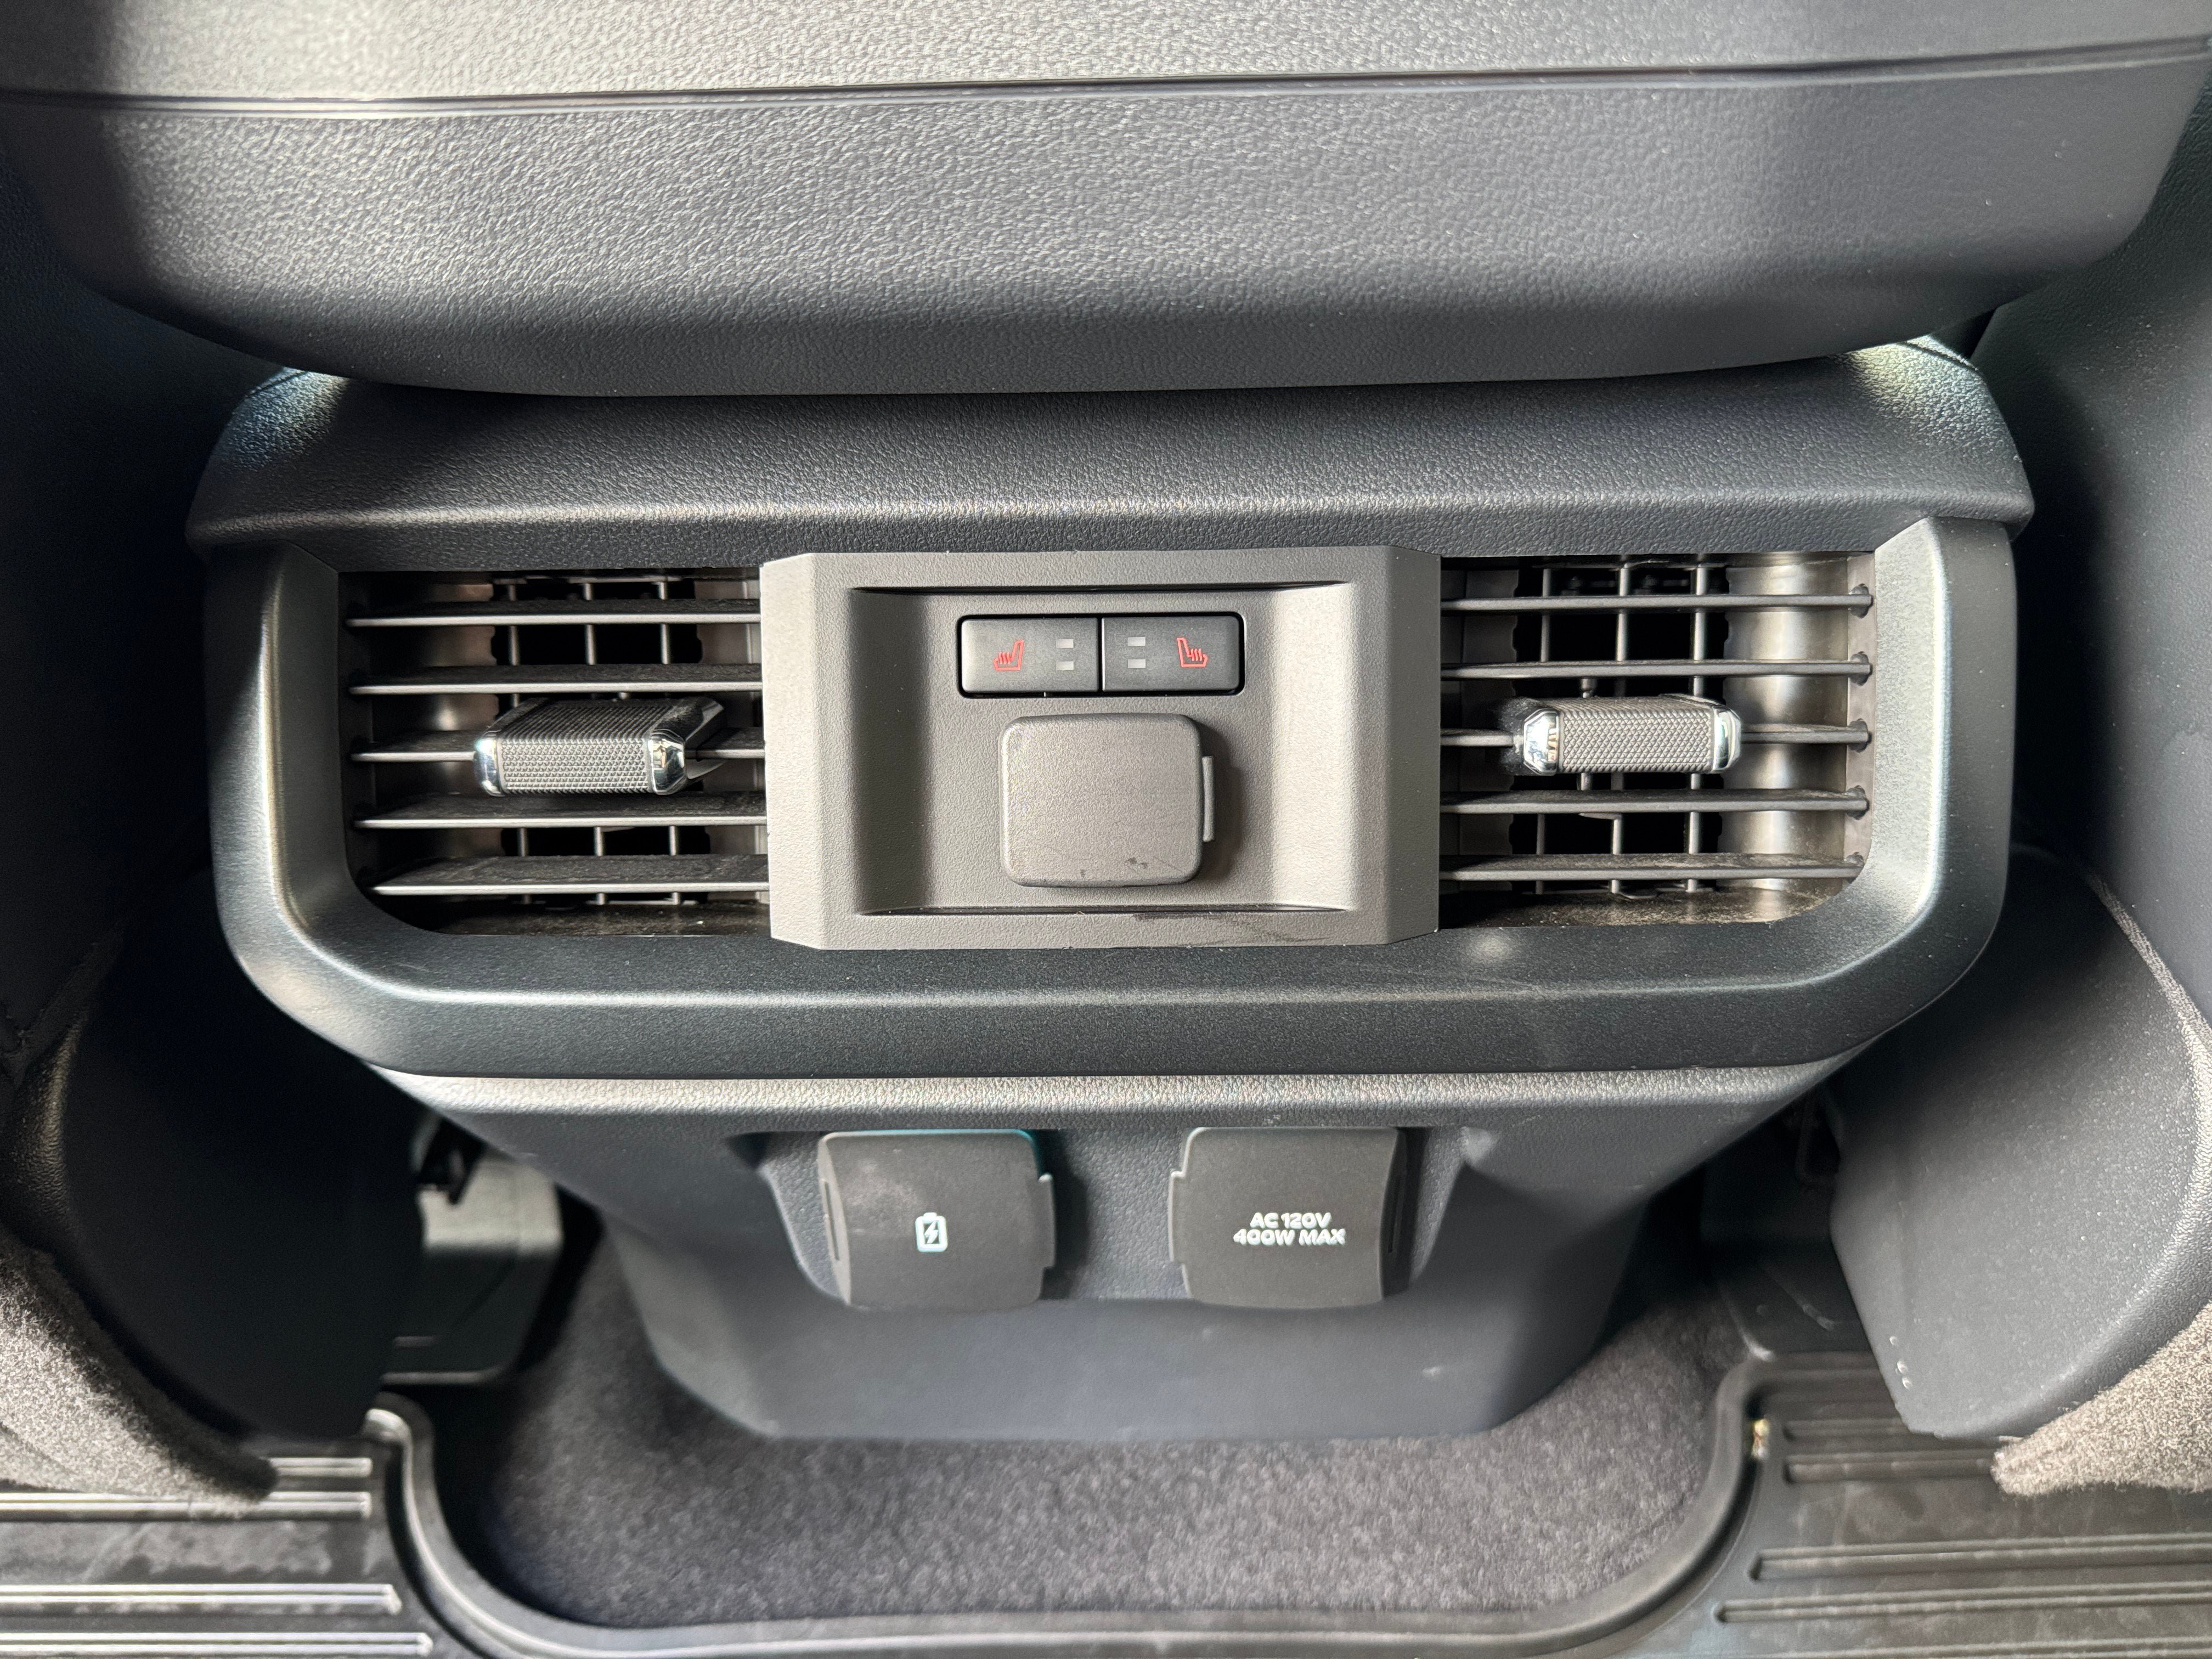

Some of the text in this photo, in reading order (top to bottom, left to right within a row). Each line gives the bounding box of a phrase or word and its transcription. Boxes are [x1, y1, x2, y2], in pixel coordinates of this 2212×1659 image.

[1249, 1212, 1332, 1229] AC 120V
[1233, 1228, 1346, 1246] 400W MAX
